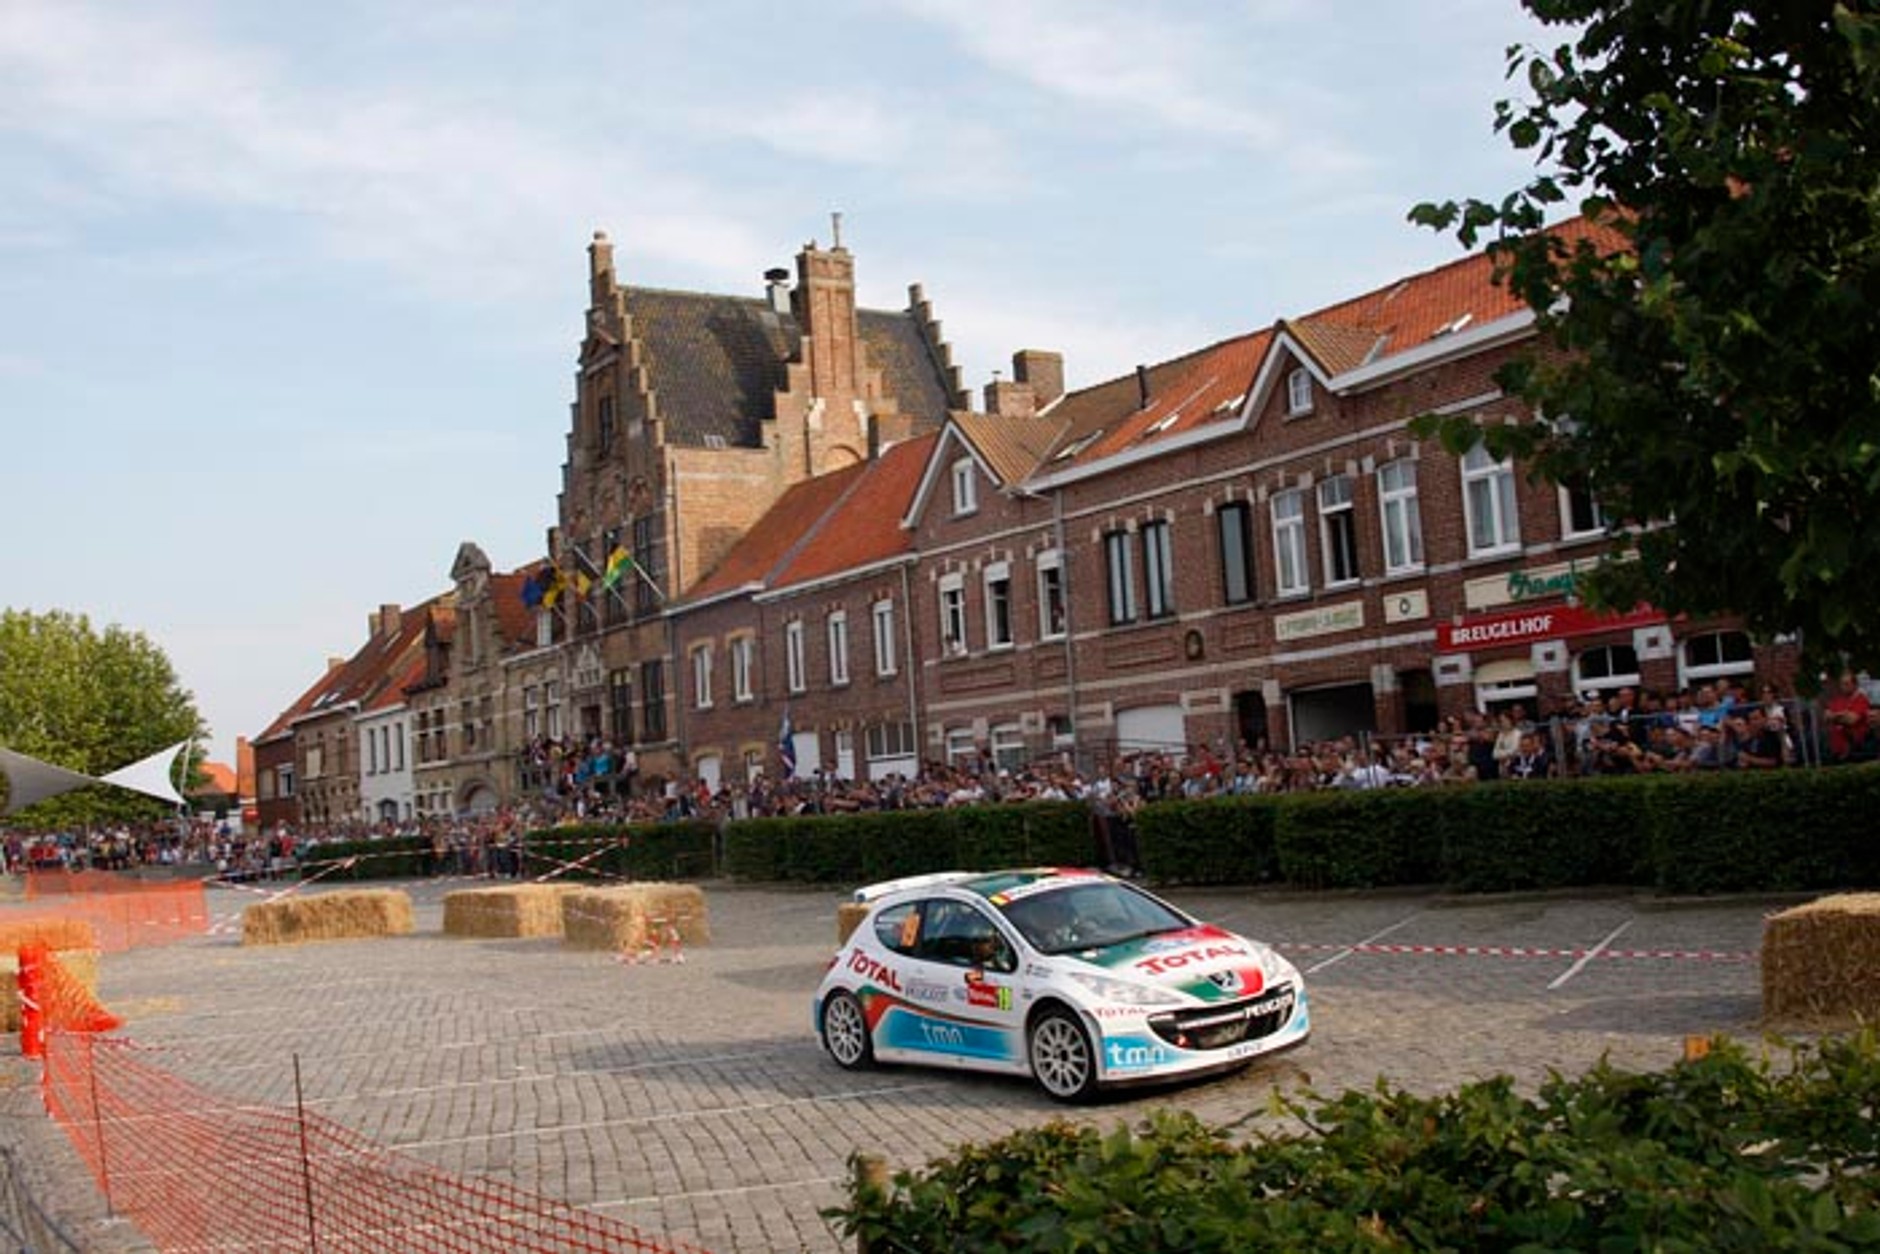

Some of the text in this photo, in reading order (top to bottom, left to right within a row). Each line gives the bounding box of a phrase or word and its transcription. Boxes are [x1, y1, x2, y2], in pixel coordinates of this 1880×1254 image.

[1452, 615, 1553, 644] BREUGELHOF
[847, 948, 903, 992] TOTAL
[1136, 945, 1249, 976] TOTAL
[1093, 1007, 1148, 1018] TOTAL
[921, 1019, 964, 1045] tmn
[1107, 1042, 1165, 1065] tmn
